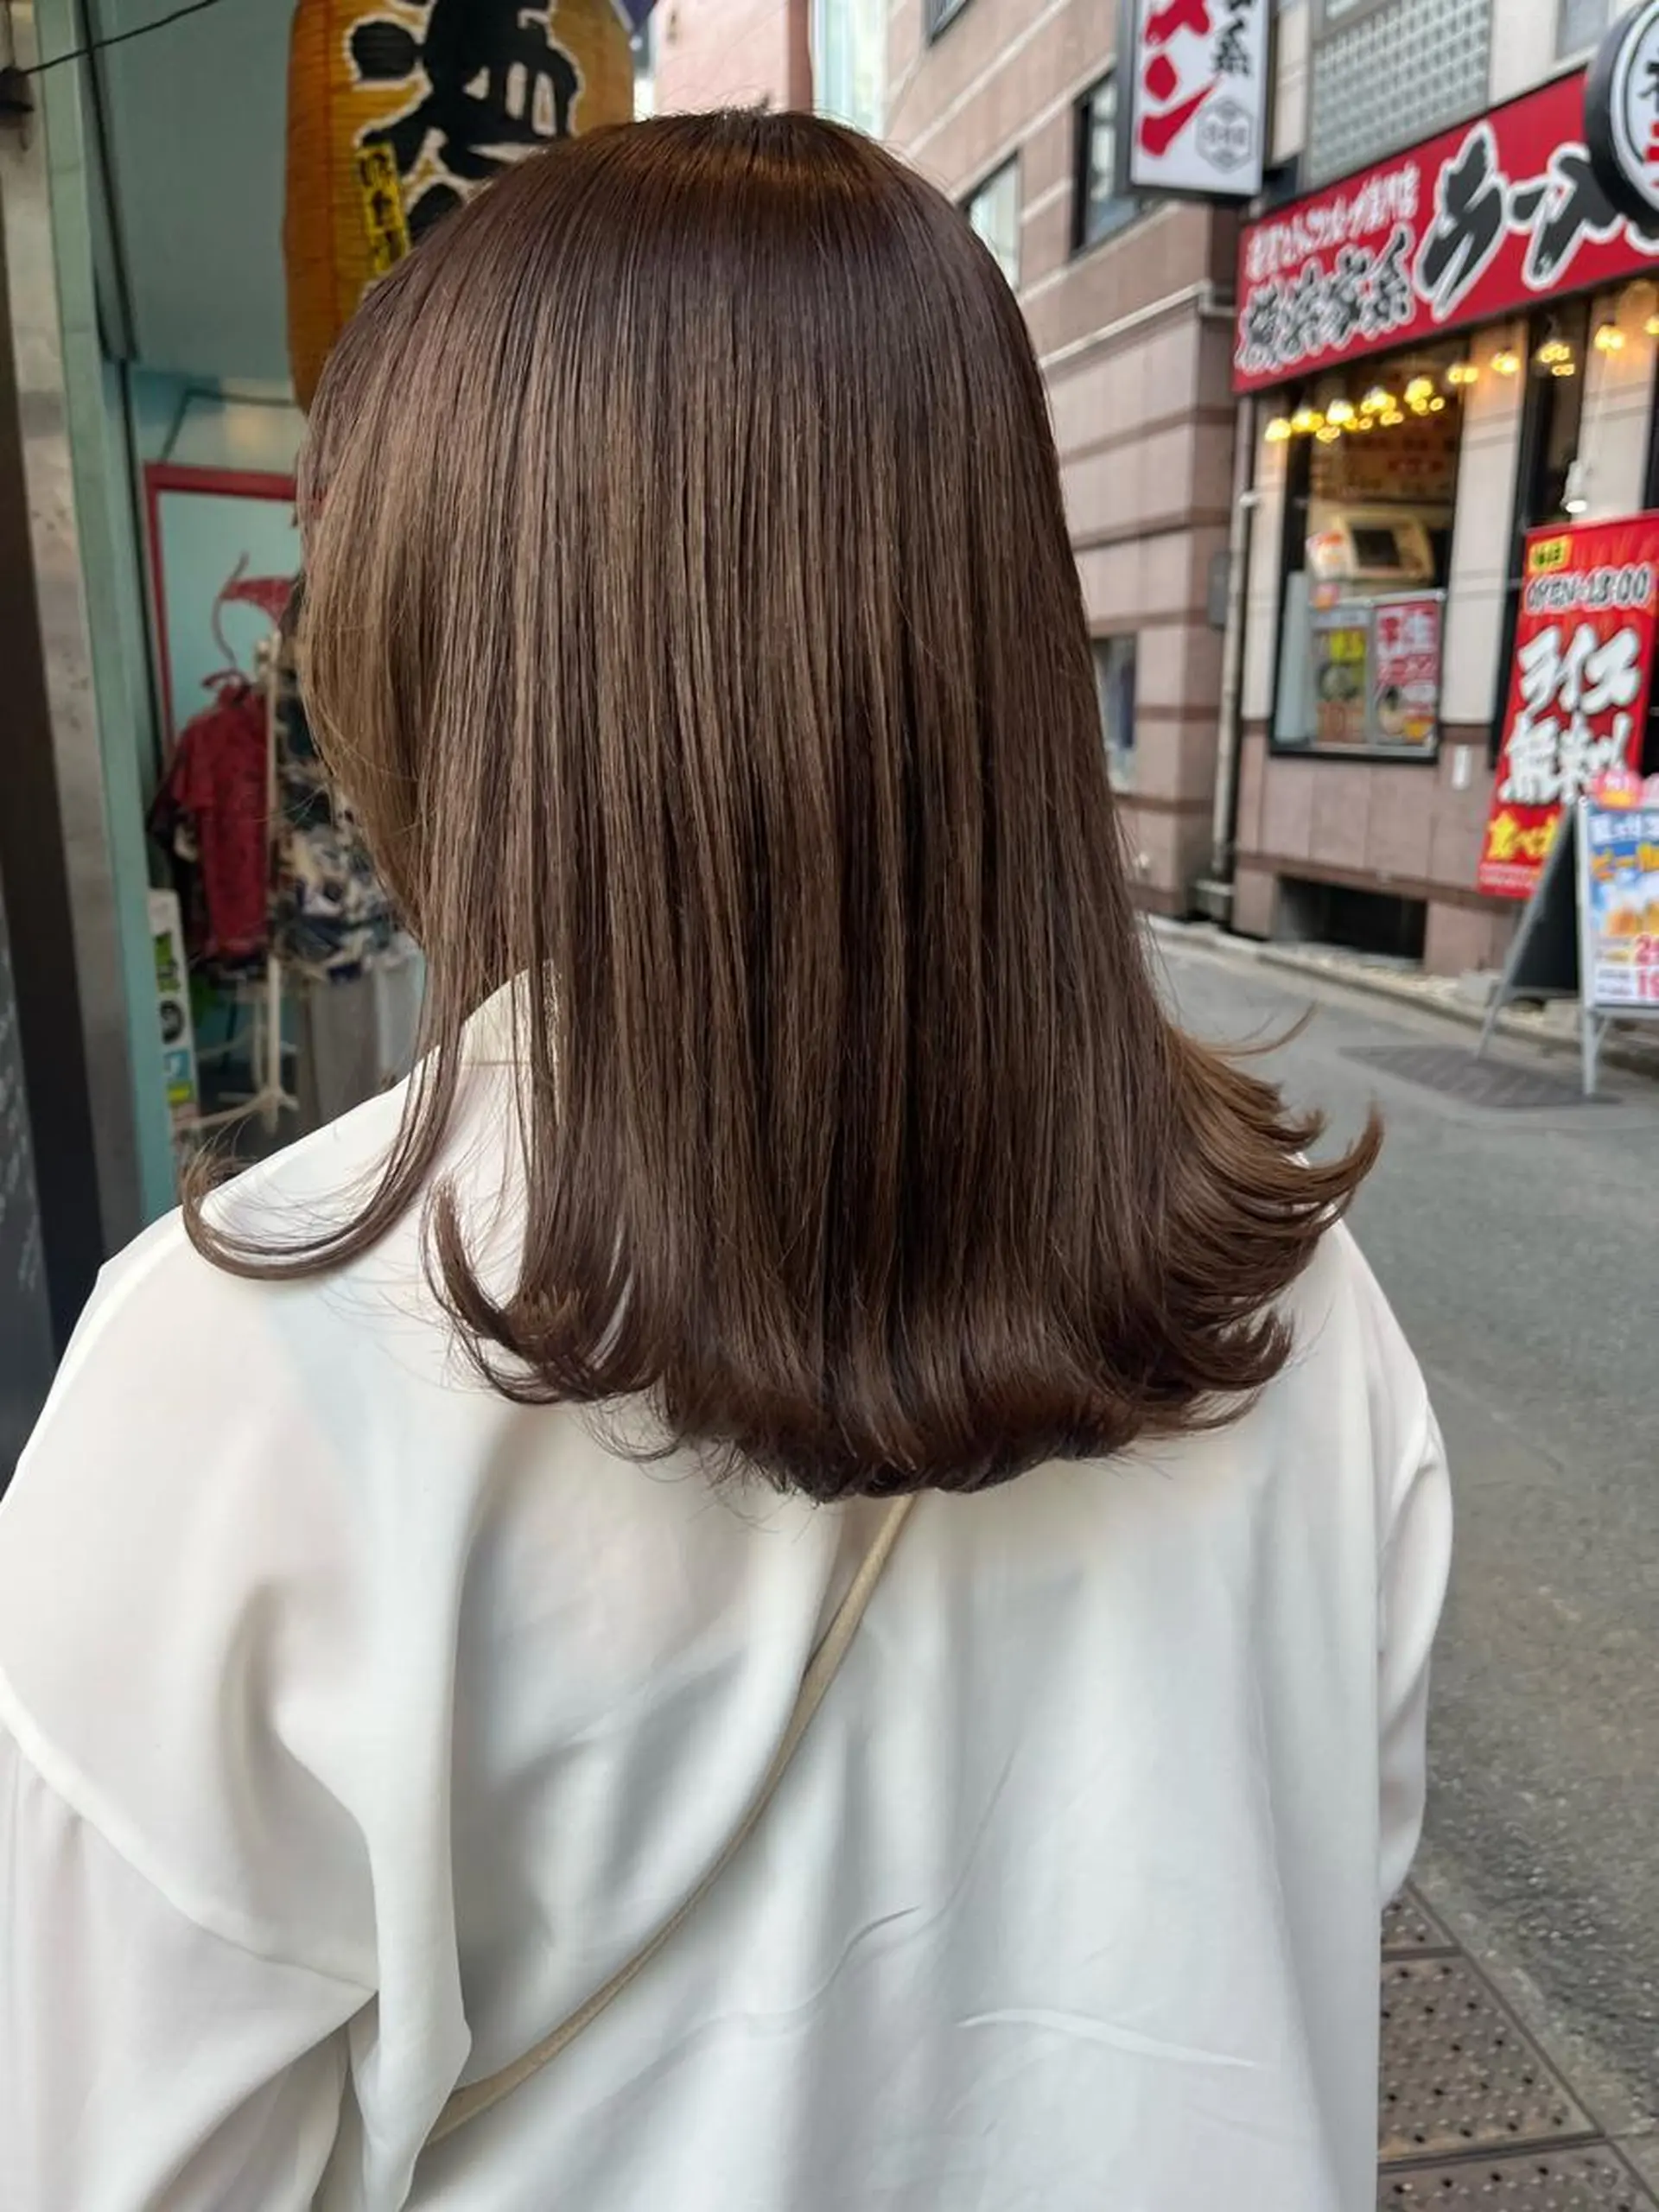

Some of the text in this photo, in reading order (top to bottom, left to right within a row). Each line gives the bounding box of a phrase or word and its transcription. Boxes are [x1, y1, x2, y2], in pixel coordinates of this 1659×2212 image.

[1517, 622, 1641, 716] ライス
[1498, 710, 1631, 805] 無料
